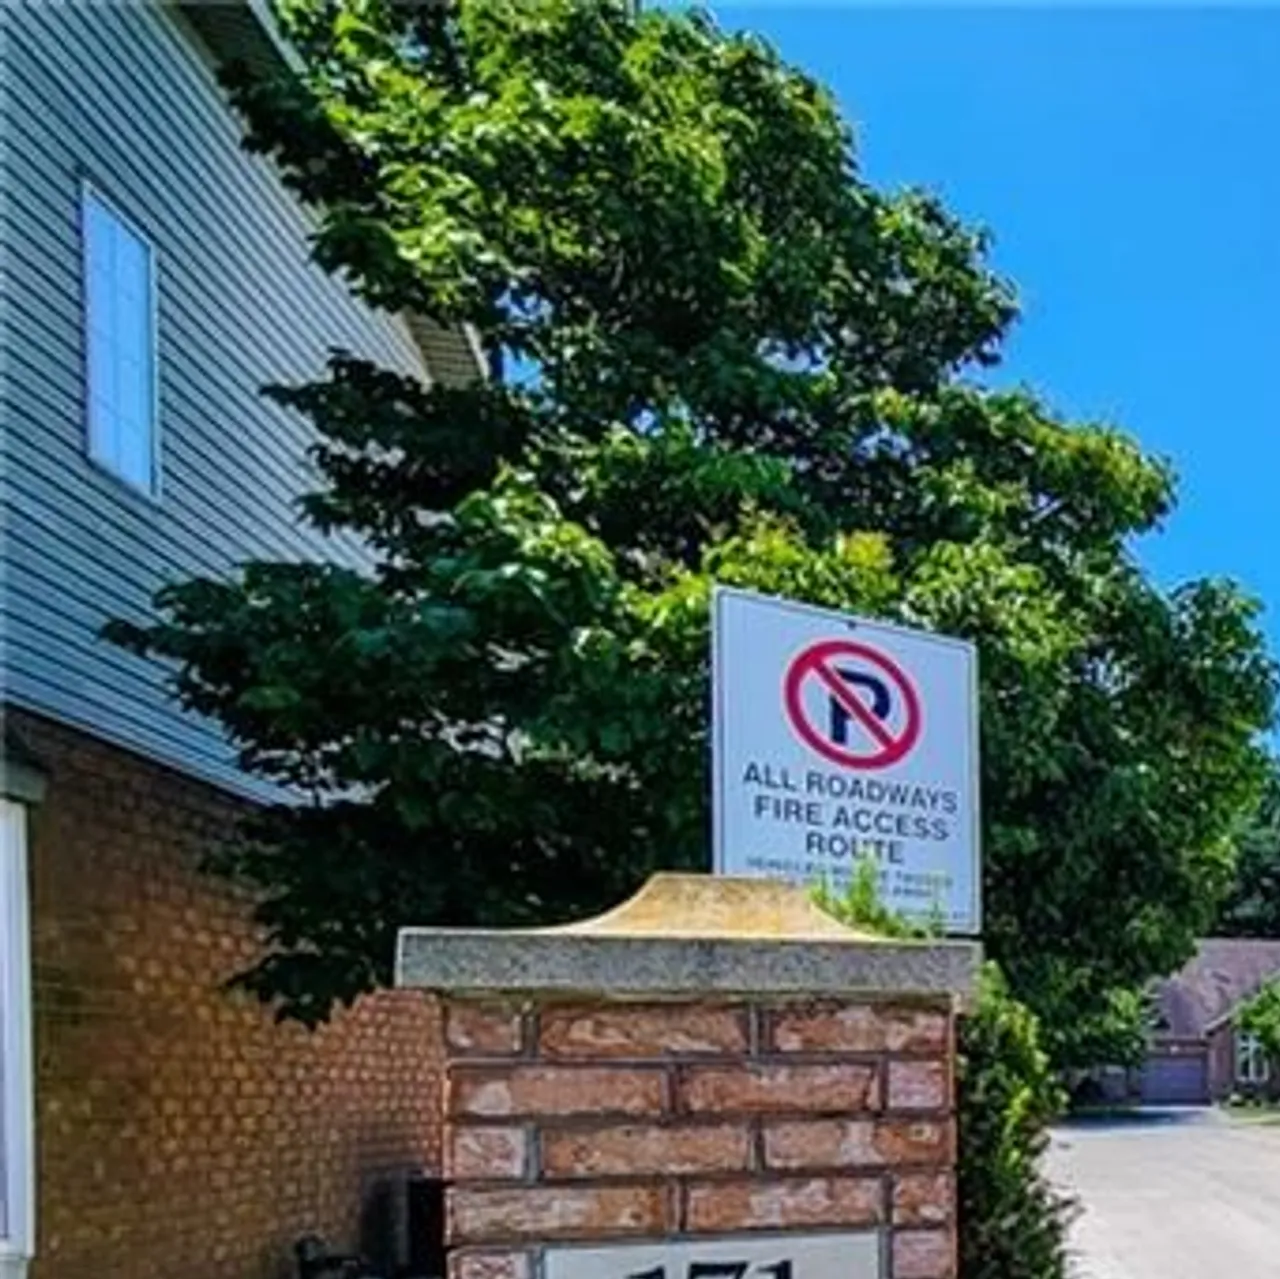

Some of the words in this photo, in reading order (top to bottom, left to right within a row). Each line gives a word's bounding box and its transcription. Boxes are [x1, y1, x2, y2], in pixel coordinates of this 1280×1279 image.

[743, 761, 796, 791] ALL
[807, 772, 959, 815] ROADWAYS
[754, 795, 825, 826] FIRE
[833, 809, 950, 841] ACCESS
[806, 832, 904, 864] ROUTE
